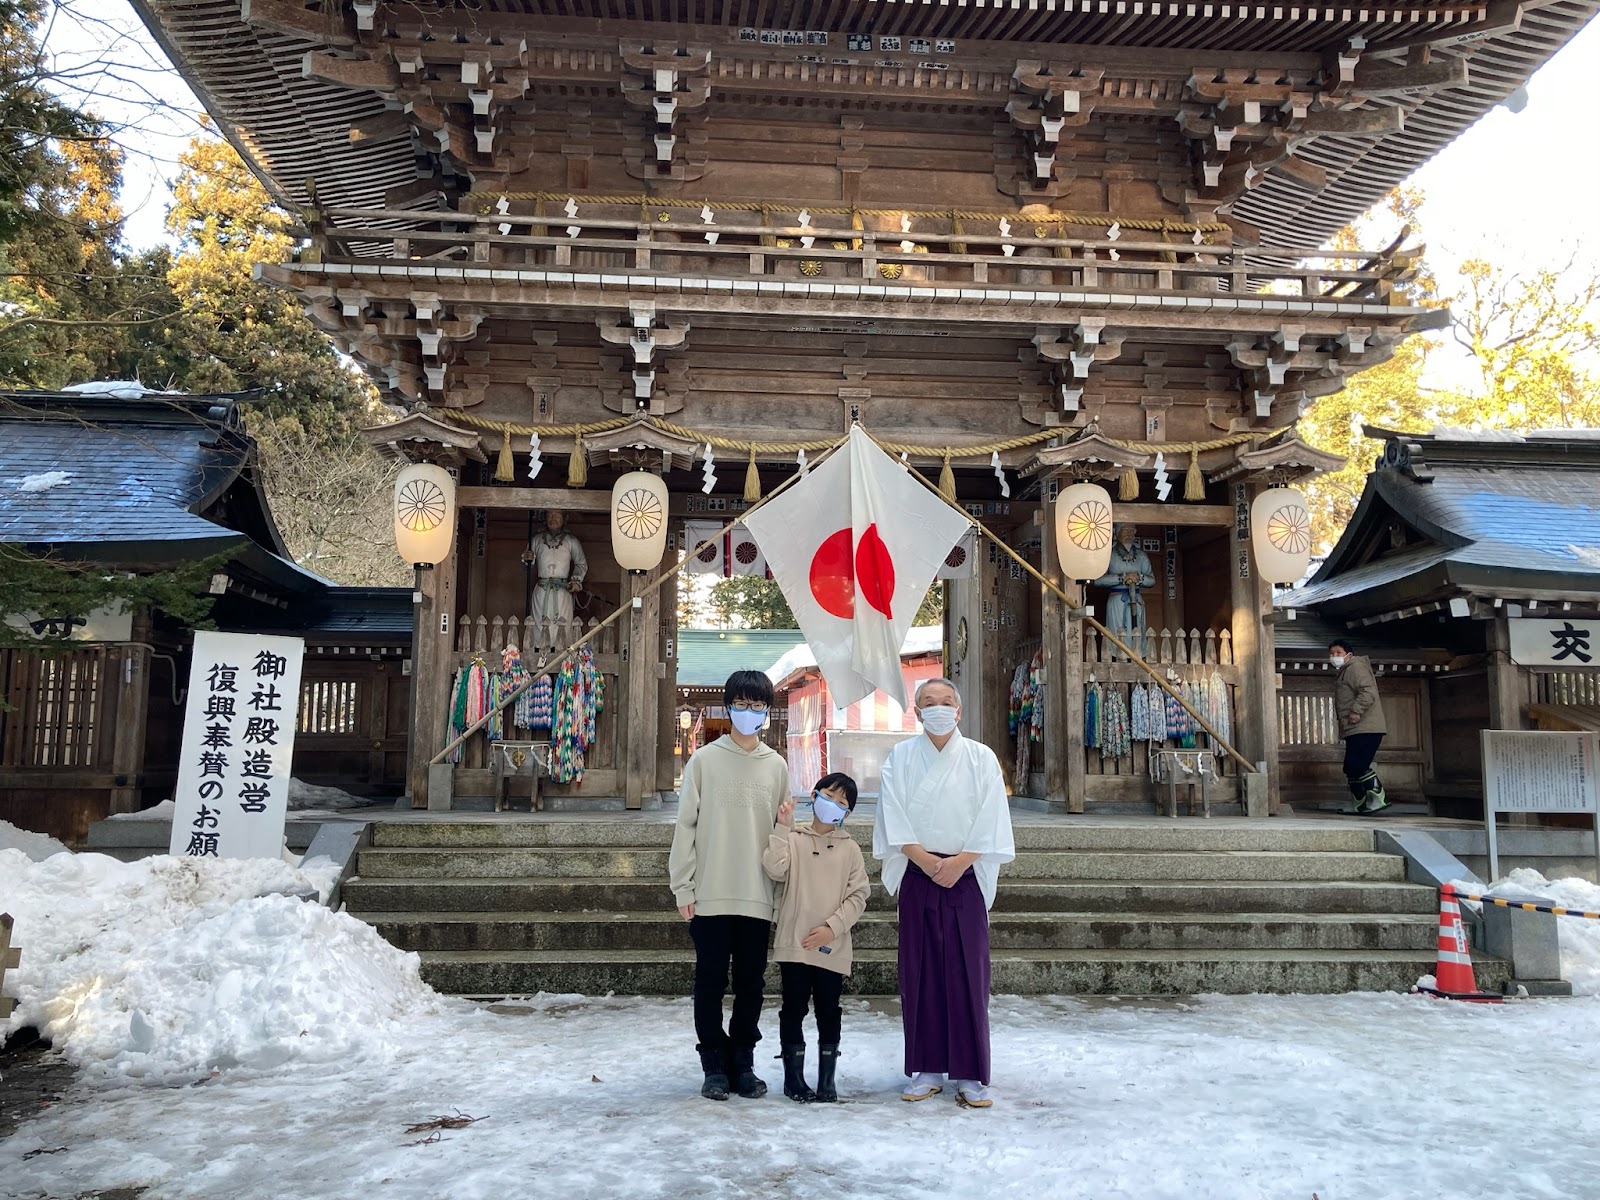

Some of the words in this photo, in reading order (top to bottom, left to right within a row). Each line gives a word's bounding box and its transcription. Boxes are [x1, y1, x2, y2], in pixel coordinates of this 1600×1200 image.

[1549, 621, 1593, 663] 交
[238, 649, 288, 814] 御社殿造営
